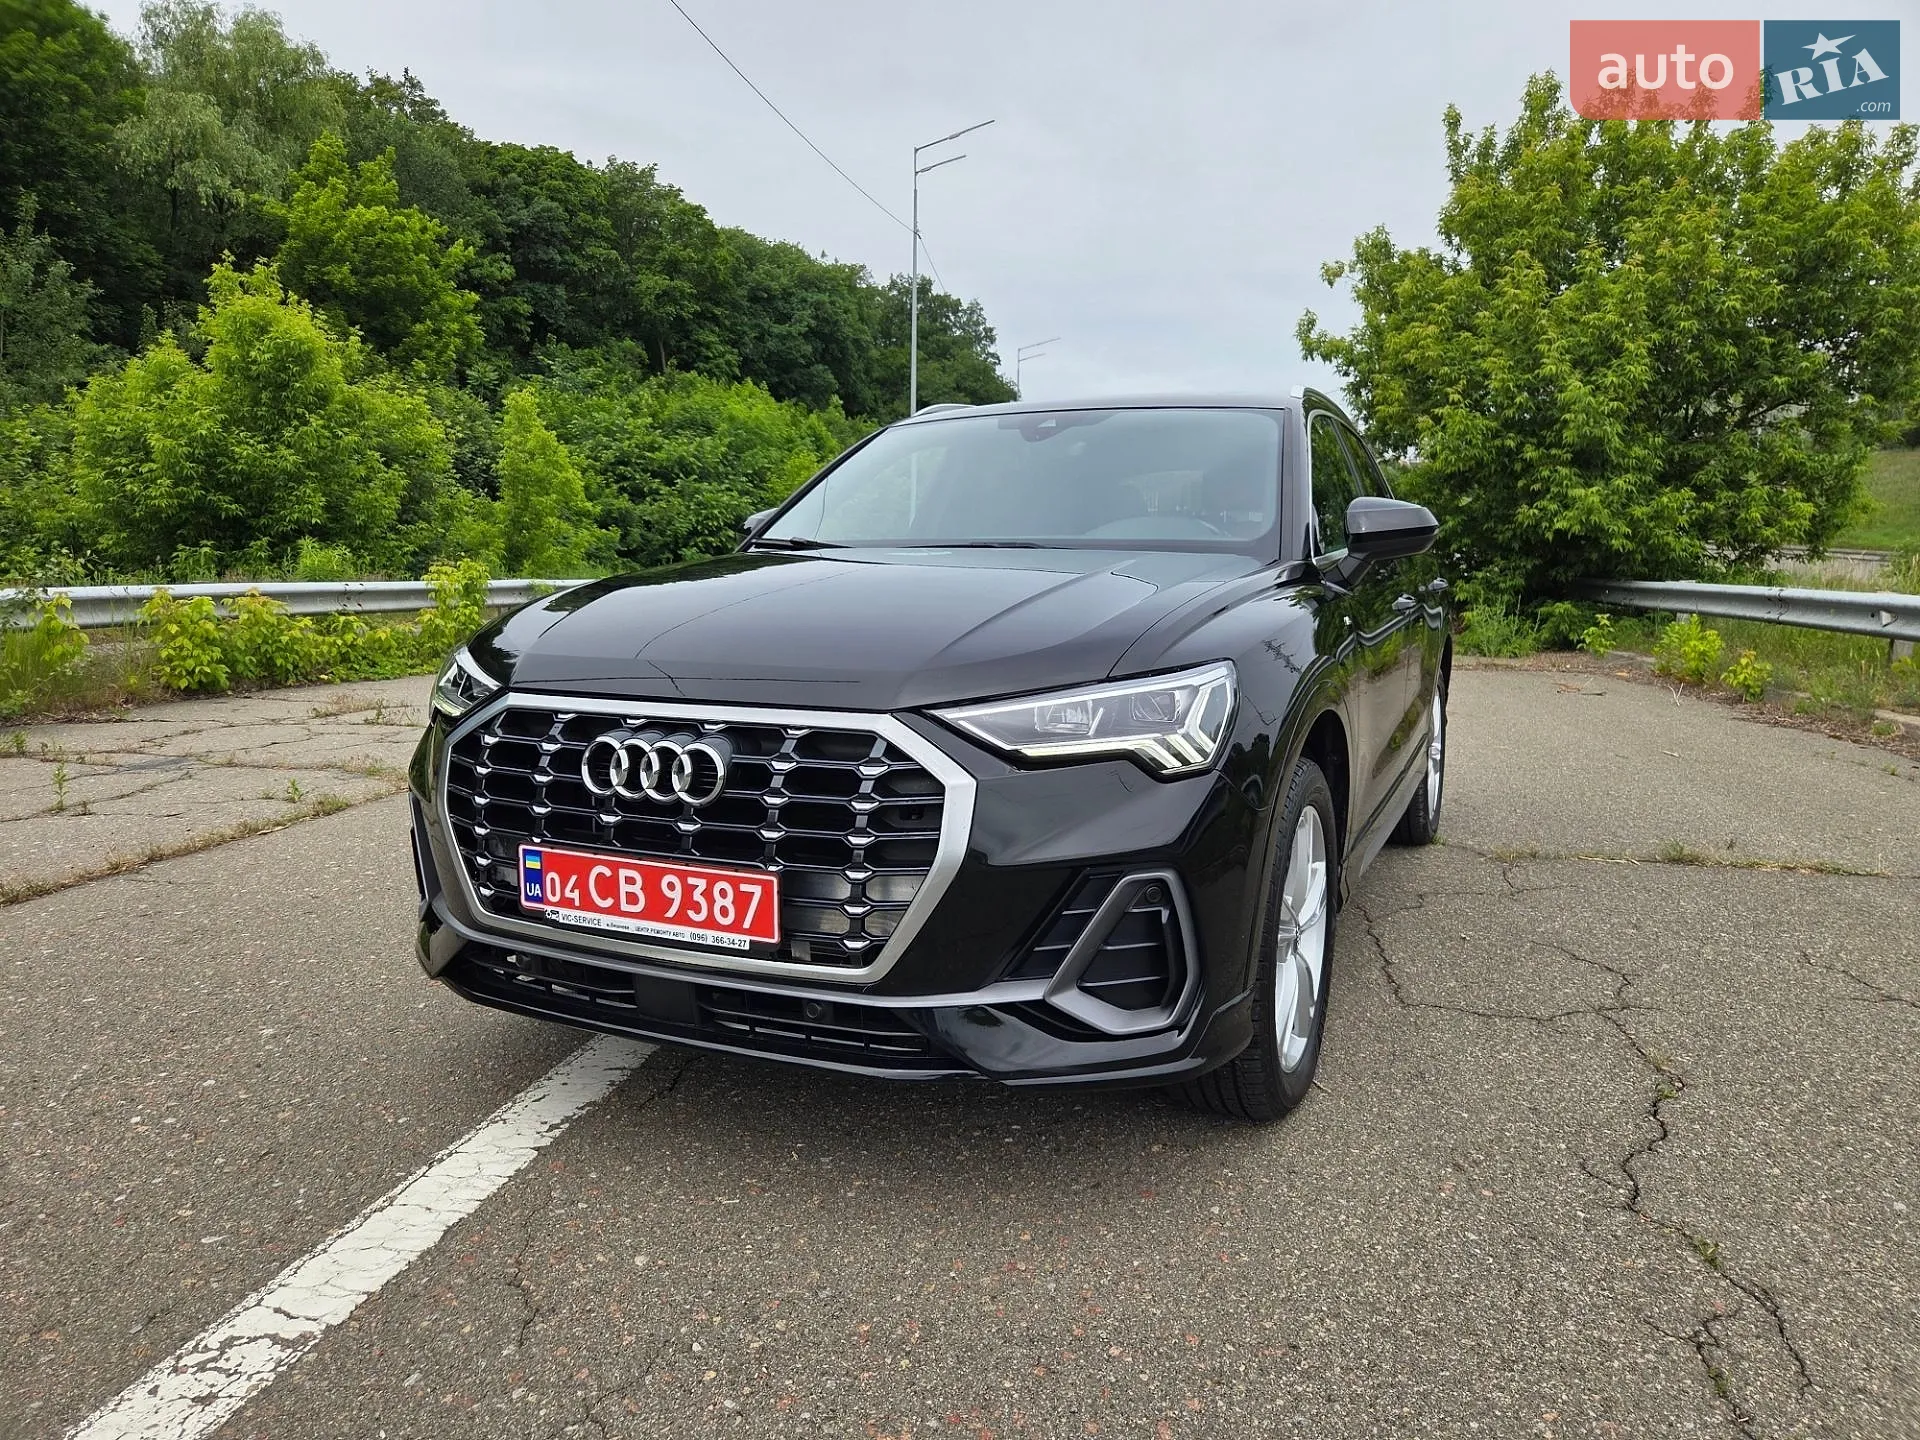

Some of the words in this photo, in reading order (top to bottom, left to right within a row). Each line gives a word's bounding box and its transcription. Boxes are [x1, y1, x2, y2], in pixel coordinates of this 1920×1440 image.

[526, 882, 542, 898] UA
[545, 872, 580, 907] 04
[588, 865, 646, 913] CB
[660, 874, 762, 929] 9387
[561, 913, 602, 927] VIC-SERVICE
[689, 931, 708, 943] (096)
[711, 935, 747, 948] 366-34-27
